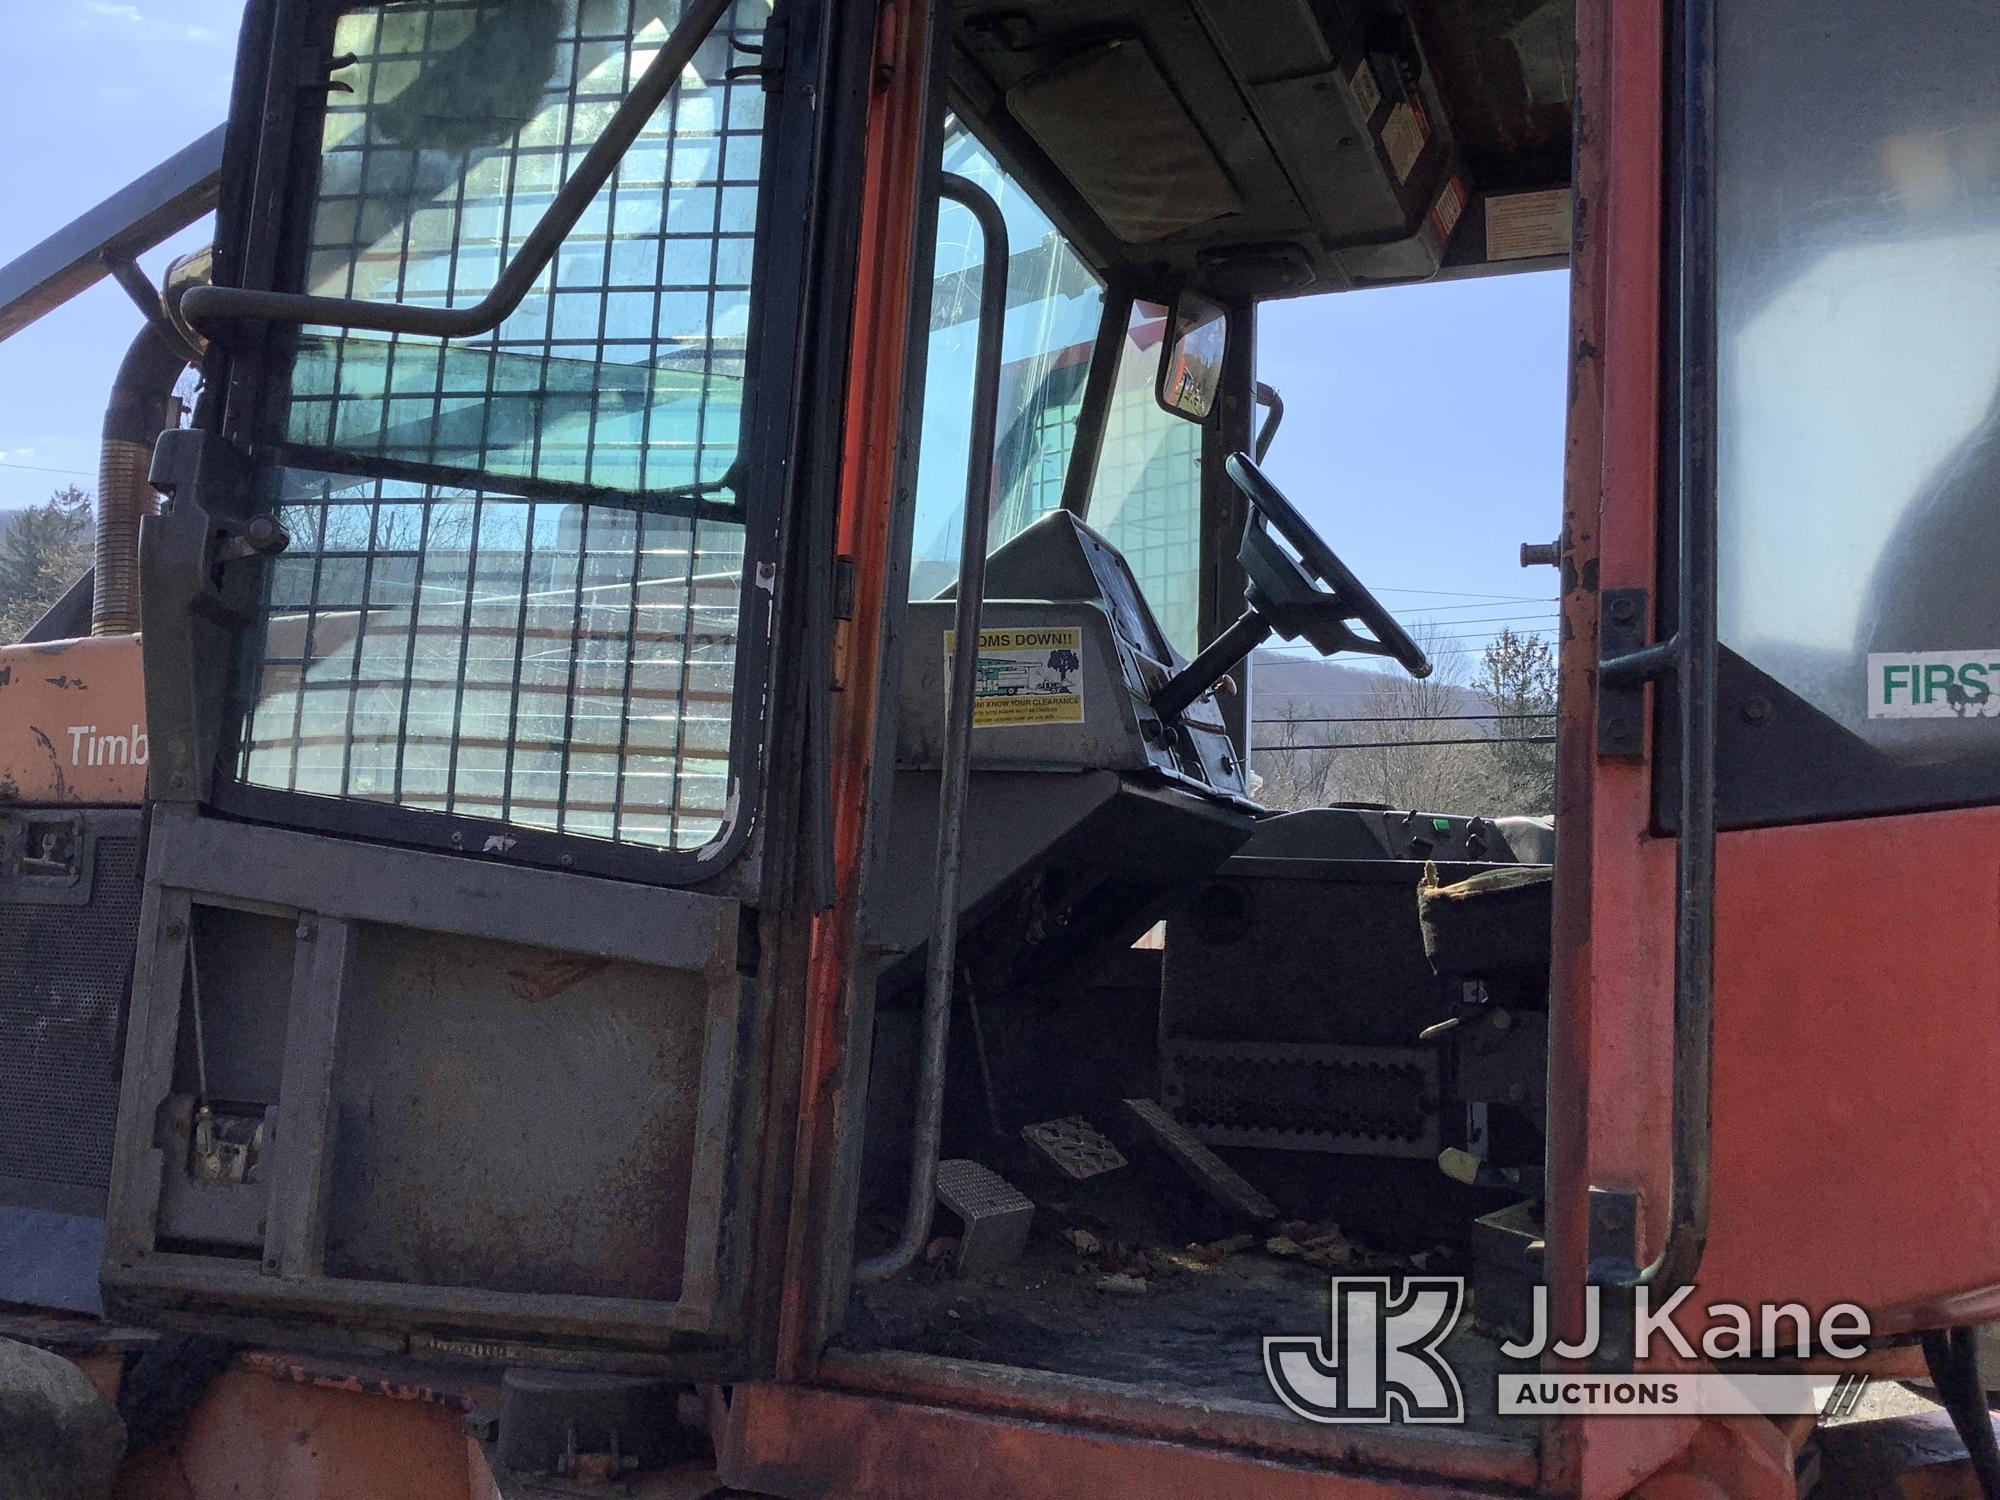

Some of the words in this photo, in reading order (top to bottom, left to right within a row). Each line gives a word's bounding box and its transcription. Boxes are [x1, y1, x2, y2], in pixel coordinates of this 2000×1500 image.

[1015, 633, 1072, 646] DOWN!!
[986, 700, 1009, 708] KNOW
[1010, 699, 1031, 707] YOUR
[1032, 697, 1079, 706] CLEARANCE
[67, 724, 149, 766] Timb
